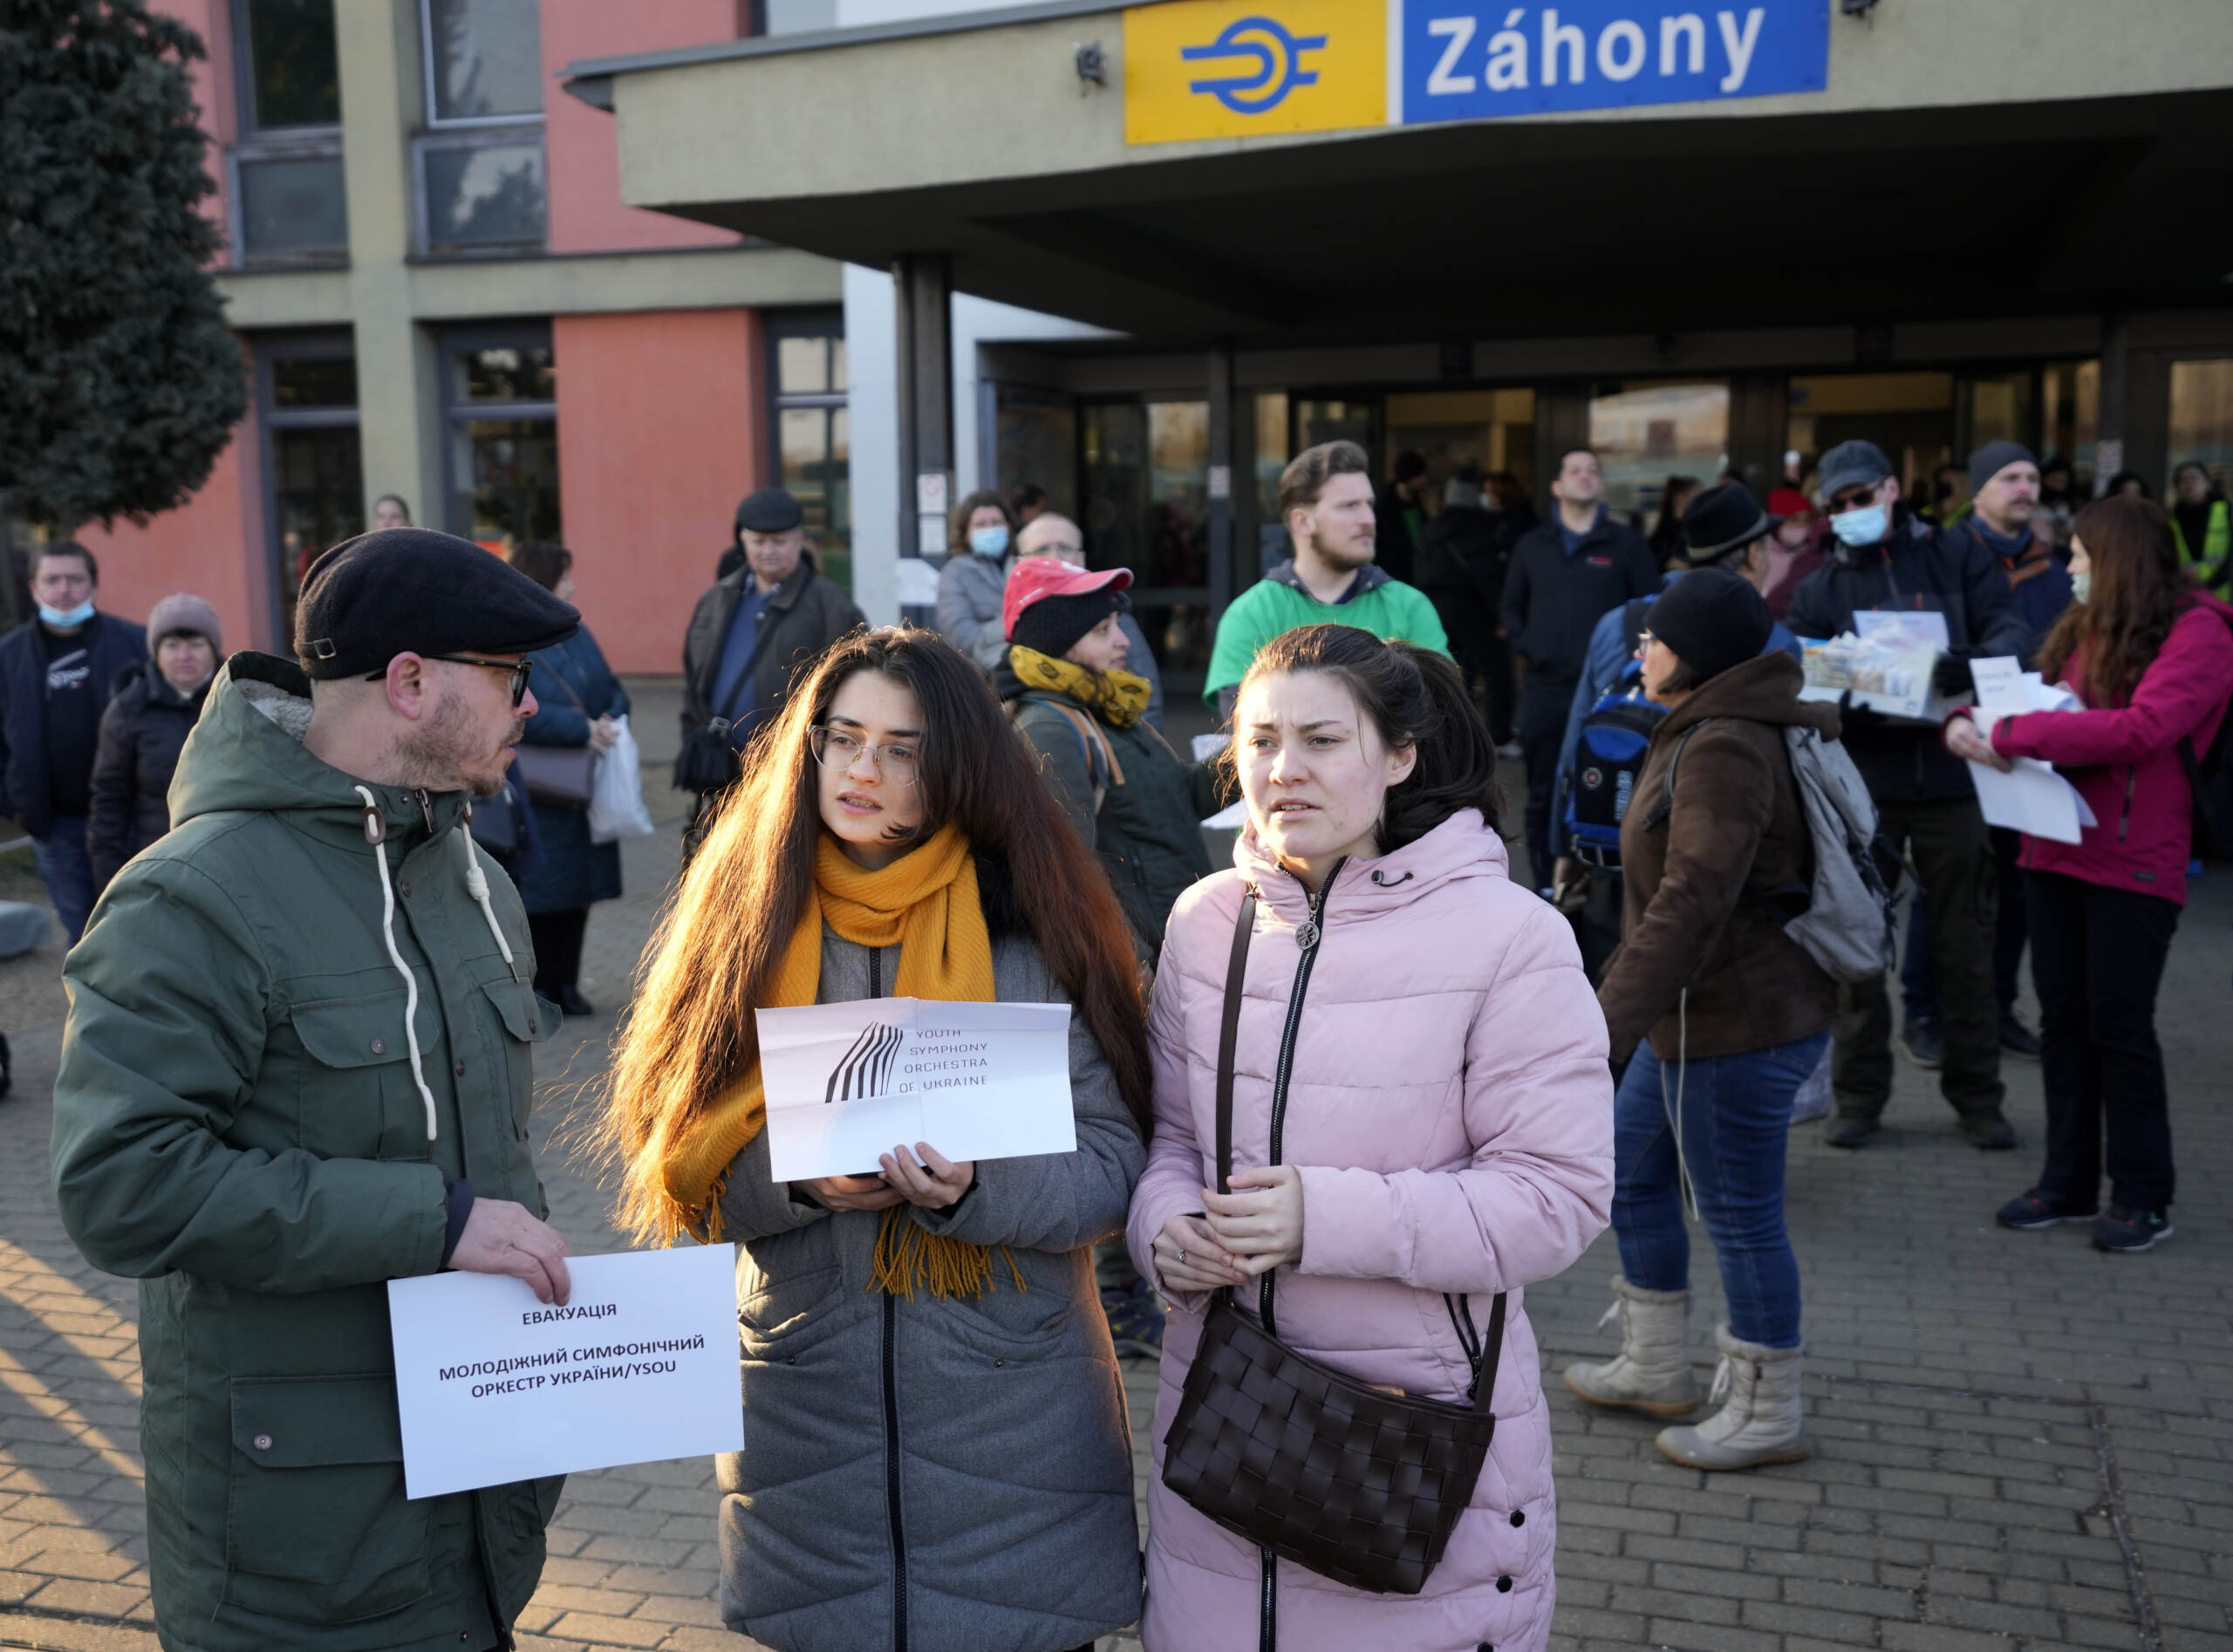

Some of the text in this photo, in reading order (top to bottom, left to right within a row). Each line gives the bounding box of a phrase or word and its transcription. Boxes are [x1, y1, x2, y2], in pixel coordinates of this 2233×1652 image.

[1426, 8, 1765, 96] Záhony
[917, 1029, 960, 1039] YOUTH
[910, 1042, 987, 1055] SYMPHONY
[905, 1058, 987, 1073] ORCHESTRA
[899, 1075, 987, 1093] OF UKRAINE
[522, 1303, 617, 1326] ЕВАКУАЦІЯ
[440, 1334, 705, 1381] МОЛОДІЖНИЙ СИМФОНІЧНИЙ
[472, 1376, 545, 1397] ОРКЕСТР
